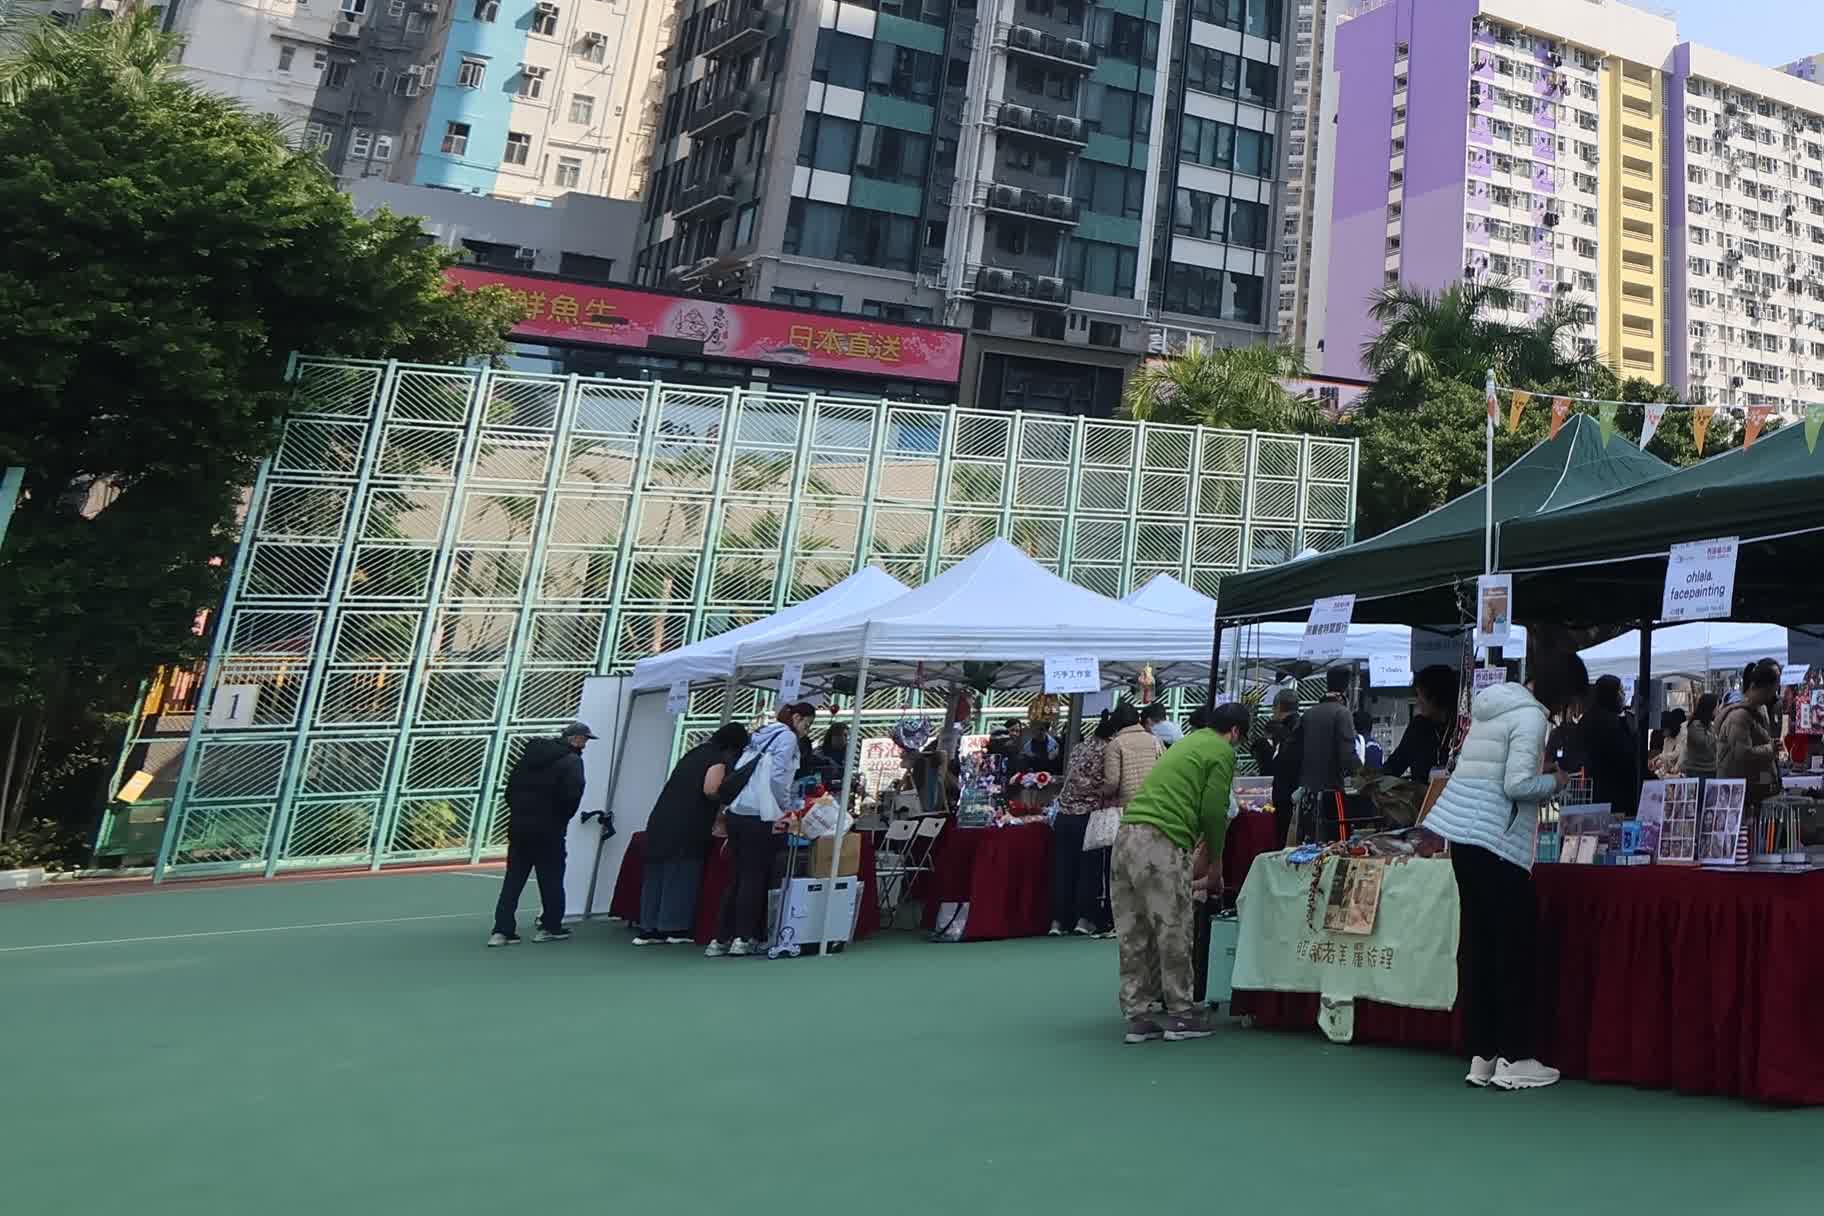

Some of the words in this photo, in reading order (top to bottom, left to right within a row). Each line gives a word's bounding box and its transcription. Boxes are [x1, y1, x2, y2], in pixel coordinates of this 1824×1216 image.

[789, 324, 902, 362] 日本直送
[1670, 584, 1726, 601] facepainting
[224, 693, 241, 720] 1
